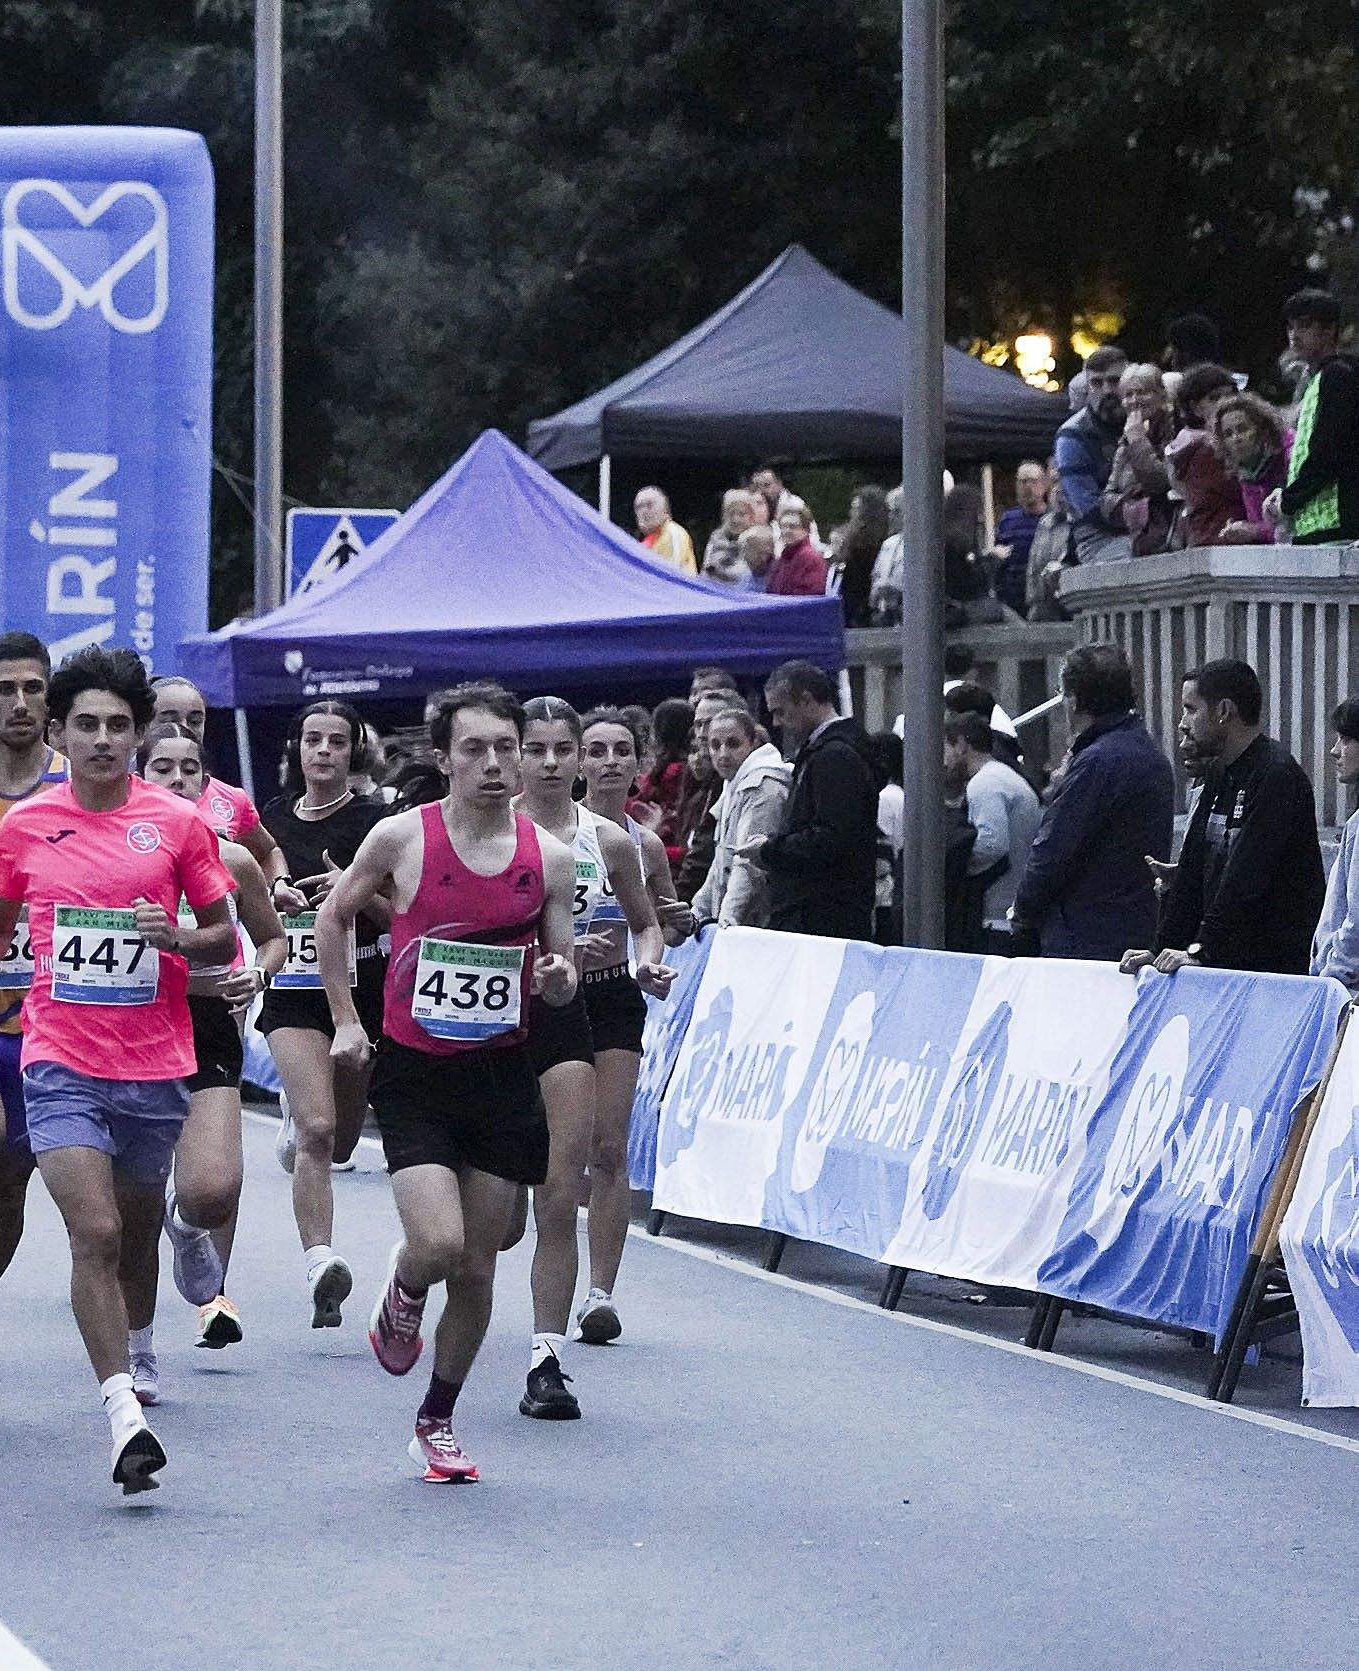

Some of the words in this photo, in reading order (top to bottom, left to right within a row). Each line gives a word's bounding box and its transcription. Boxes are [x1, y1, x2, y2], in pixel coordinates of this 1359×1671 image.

[58, 935, 147, 974] 447
[418, 969, 511, 1011] 438
[1162, 1096, 1256, 1213] MAR
